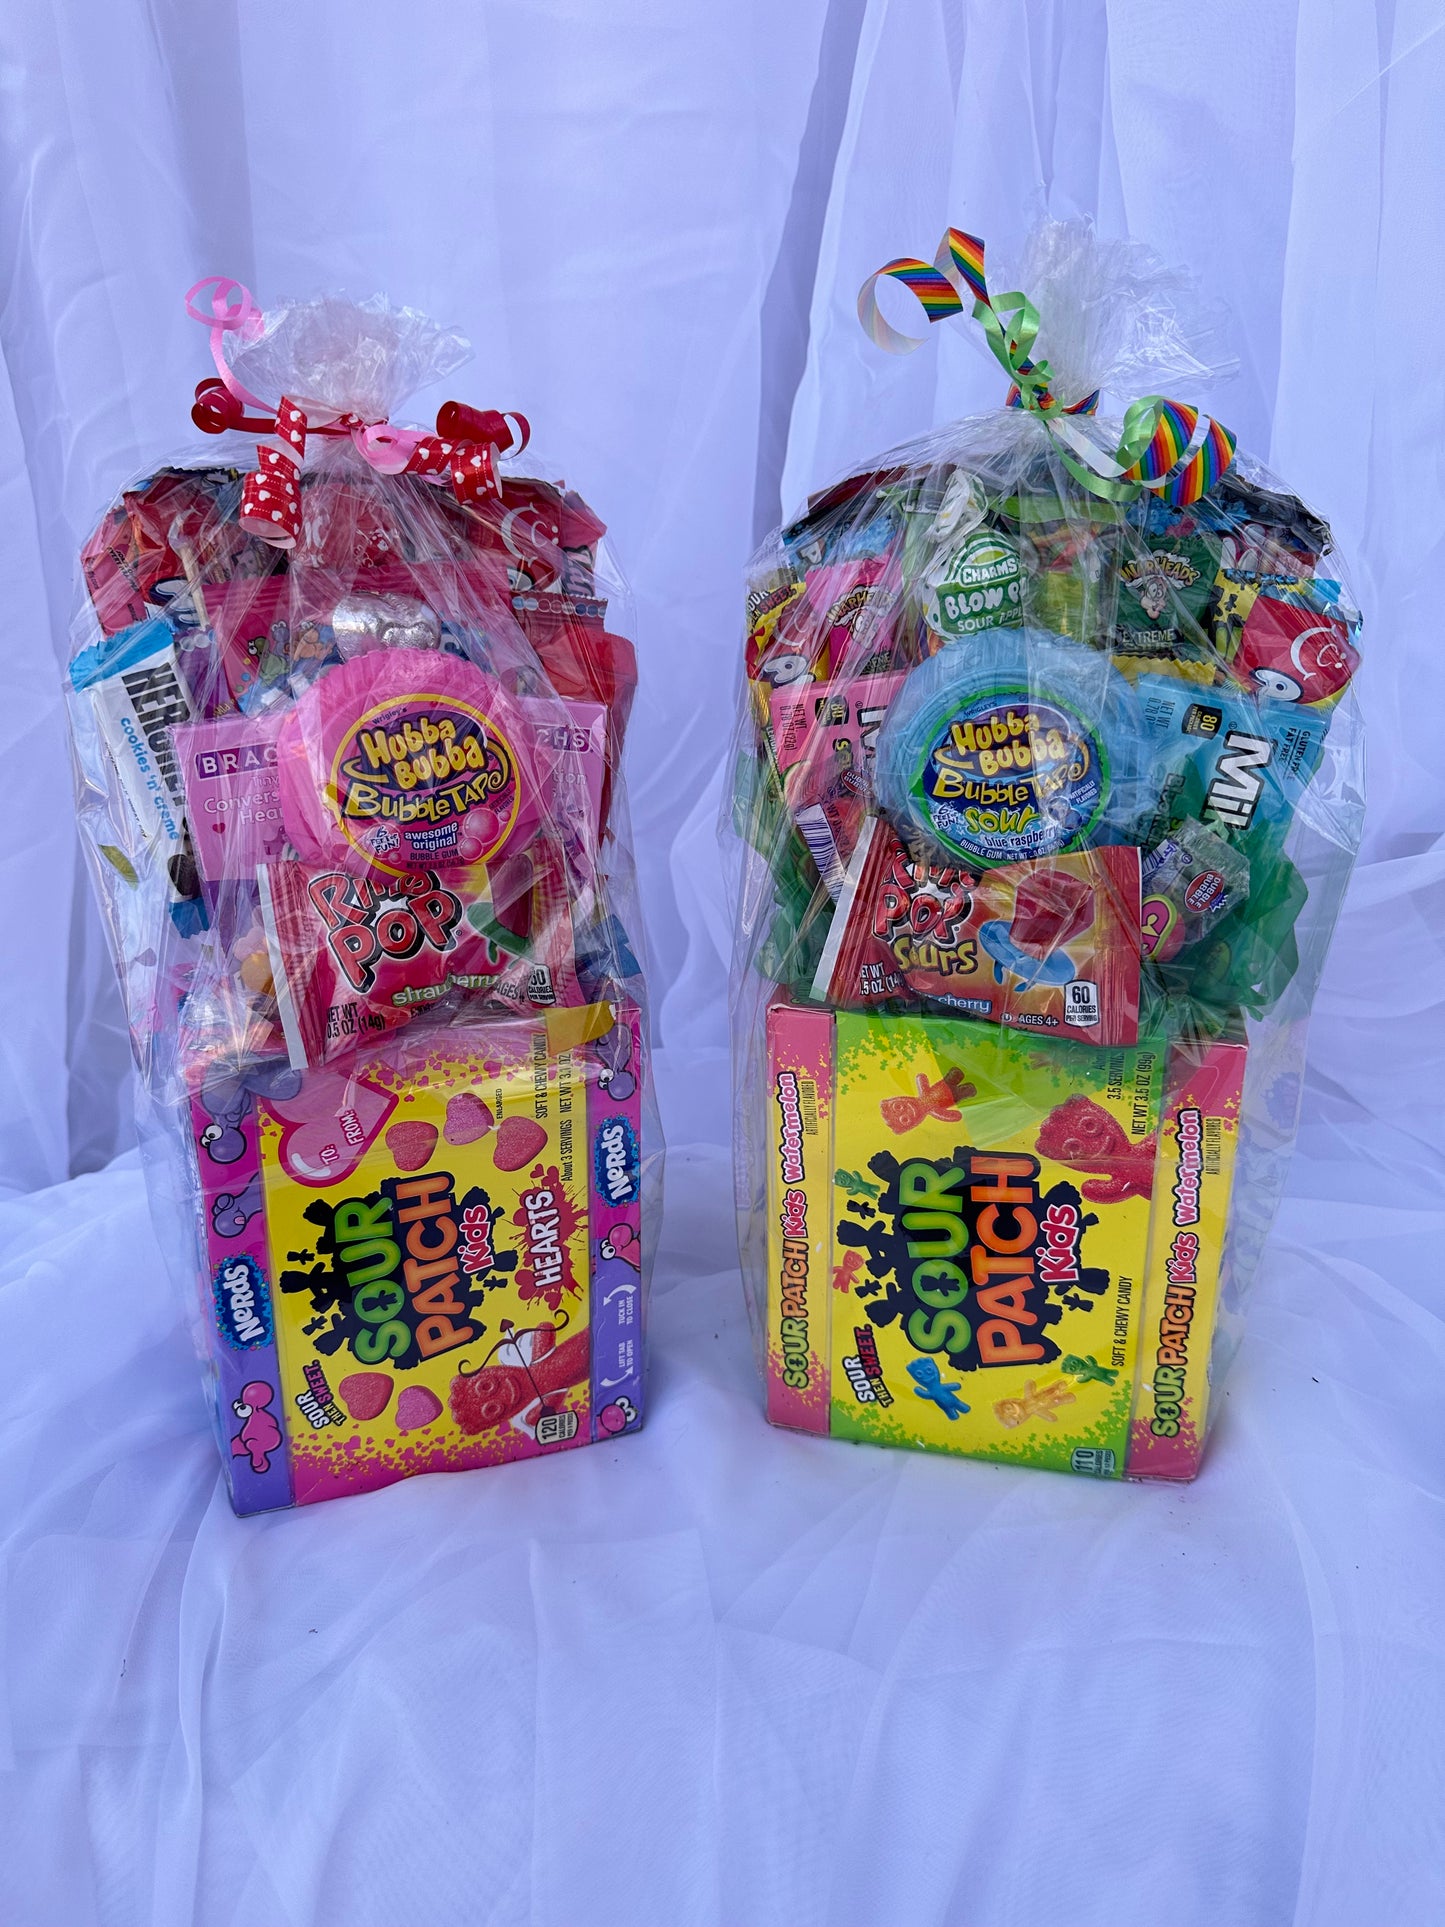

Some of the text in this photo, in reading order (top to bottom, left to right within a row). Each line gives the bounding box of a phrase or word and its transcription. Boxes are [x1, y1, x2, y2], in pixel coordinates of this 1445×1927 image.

[962, 557, 1018, 584] CHARMS
[944, 586, 1004, 620] BLOW
[957, 615, 994, 632] SOUR
[951, 711, 1041, 755] Hubba
[1200, 715, 1217, 731] 80
[1285, 727, 1297, 744] FAT
[360, 717, 457, 769] Hubba
[978, 729, 1067, 776] Bubba
[1294, 730, 1311, 761] GLUTEN
[394, 735, 485, 790] Bubba
[120, 717, 151, 773] cookies
[153, 796, 181, 841] creme
[931, 767, 1030, 806] Bubble
[344, 782, 452, 823] Bubble
[375, 838, 399, 854] FUN!
[404, 822, 459, 840] awesome
[413, 836, 457, 851] original
[984, 836, 1008, 847] blue
[410, 848, 459, 861] BUBBLE GUM
[960, 839, 985, 855] BUBBLE
[985, 850, 1003, 859] GUM
[1187, 873, 1215, 905] BUBBLE
[1195, 877, 1221, 909] DUBBLE
[328, 887, 463, 994] POP
[870, 962, 885, 979] WT
[871, 979, 885, 994] OZ
[1072, 986, 1090, 1004] 60
[342, 1002, 359, 1020] WT
[937, 992, 992, 1013] cherry
[1066, 1004, 1097, 1015] CALORIES
[341, 1018, 357, 1036] OZ
[358, 1013, 387, 1035] (14g)
[1018, 1014, 1059, 1026] AGES 4+
[535, 1062, 548, 1091] CHEWY
[558, 1081, 572, 1096] WT
[559, 1098, 572, 1113] NET
[1106, 1087, 1121, 1100] 3.5
[1131, 1051, 1156, 1135] NET WT 3.5 OZ (99g)
[535, 1099, 548, 1119] SOFT
[559, 1119, 573, 1153] SERVINGS
[1205, 1118, 1222, 1176] ARTIFICIALLY FLAVORED
[319, 1144, 339, 1165] TO:
[560, 1161, 573, 1182] About
[782, 1190, 807, 1238] Kids
[457, 1204, 496, 1274] Kids
[523, 1190, 564, 1288] HEARTS
[1035, 1203, 1080, 1283] Kids
[396, 1175, 474, 1357] PATCH
[899, 1162, 972, 1353] SOUR
[970, 1155, 1045, 1363] PATCH
[1165, 1231, 1199, 1284] Kids
[334, 1196, 411, 1362] SOUR
[780, 1241, 809, 1318] PATCH
[1118, 1276, 1133, 1307] CANDY
[1116, 1306, 1129, 1337] CHEWY
[1157, 1284, 1197, 1366] PATCH
[780, 1318, 809, 1389] SOUR
[1112, 1345, 1125, 1367] SOFT
[843, 1356, 876, 1403] SOUR
[872, 1377, 894, 1408] THEN
[296, 1390, 331, 1429] SOUR
[324, 1399, 348, 1427] THEN
[1152, 1365, 1187, 1438] SOUR
[541, 1416, 558, 1441] 120
[1074, 1450, 1094, 1470] 110
